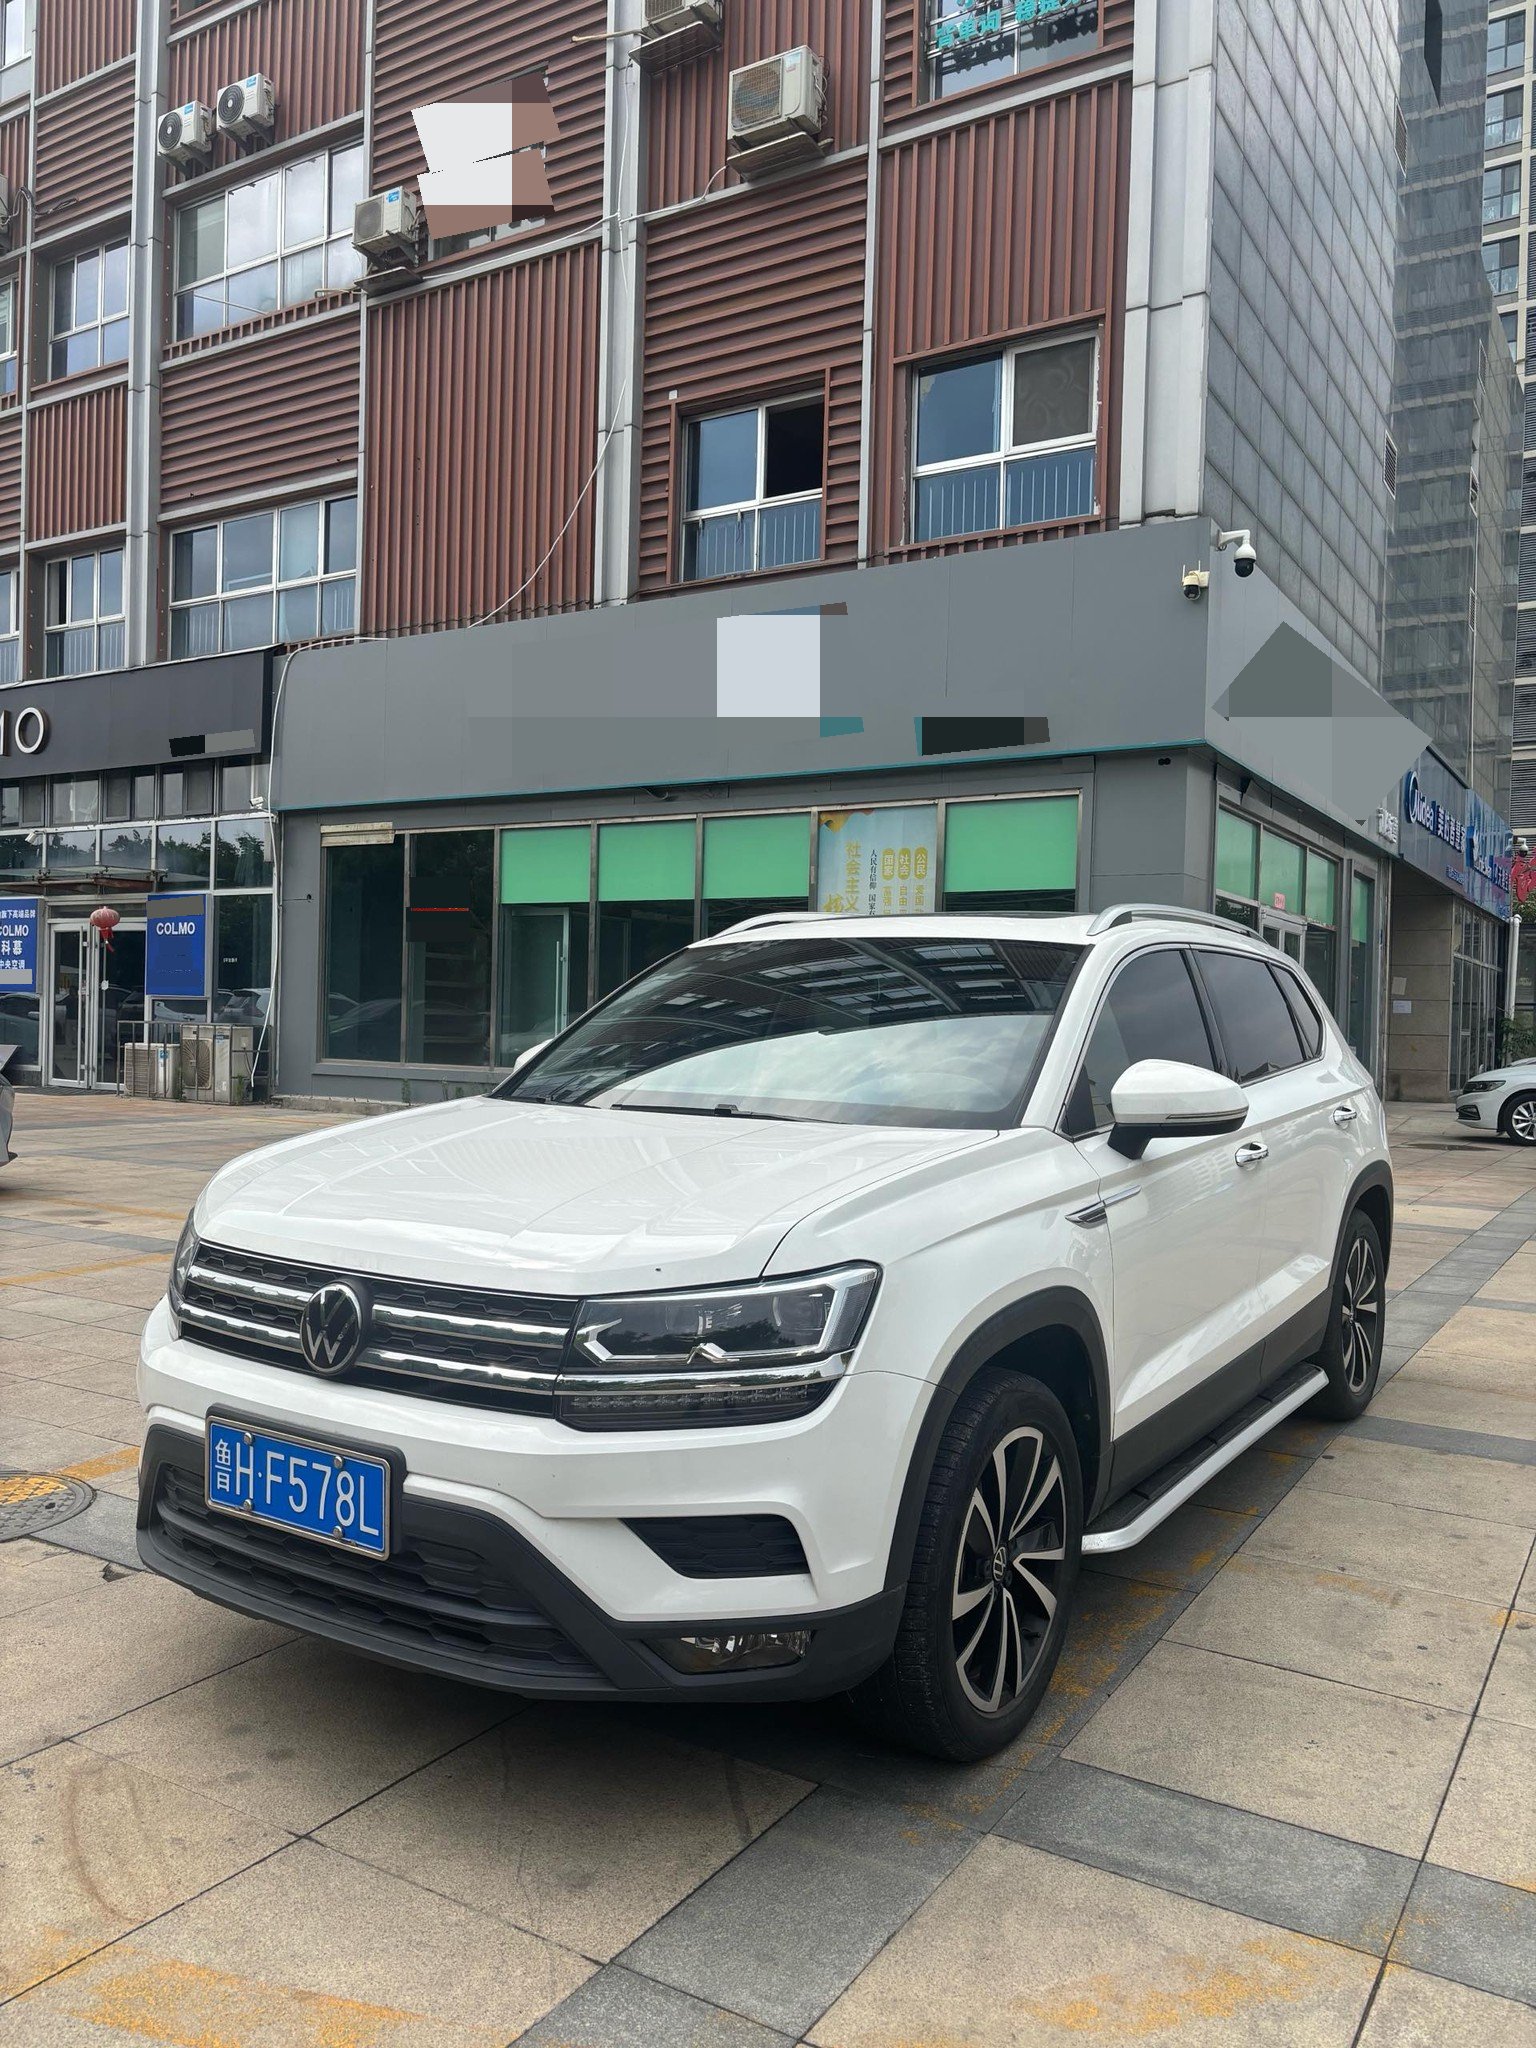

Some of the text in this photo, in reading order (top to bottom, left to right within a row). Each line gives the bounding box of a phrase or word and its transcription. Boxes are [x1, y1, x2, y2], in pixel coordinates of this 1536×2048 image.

[935, 10, 1001, 49] 背单词
[899, 853, 910, 876] 社会
[916, 853, 926, 875] 公民
[0, 909, 36, 919] 旗下高端品牌
[156, 922, 196, 935] COLMO
[1, 940, 23, 956] 科慕
